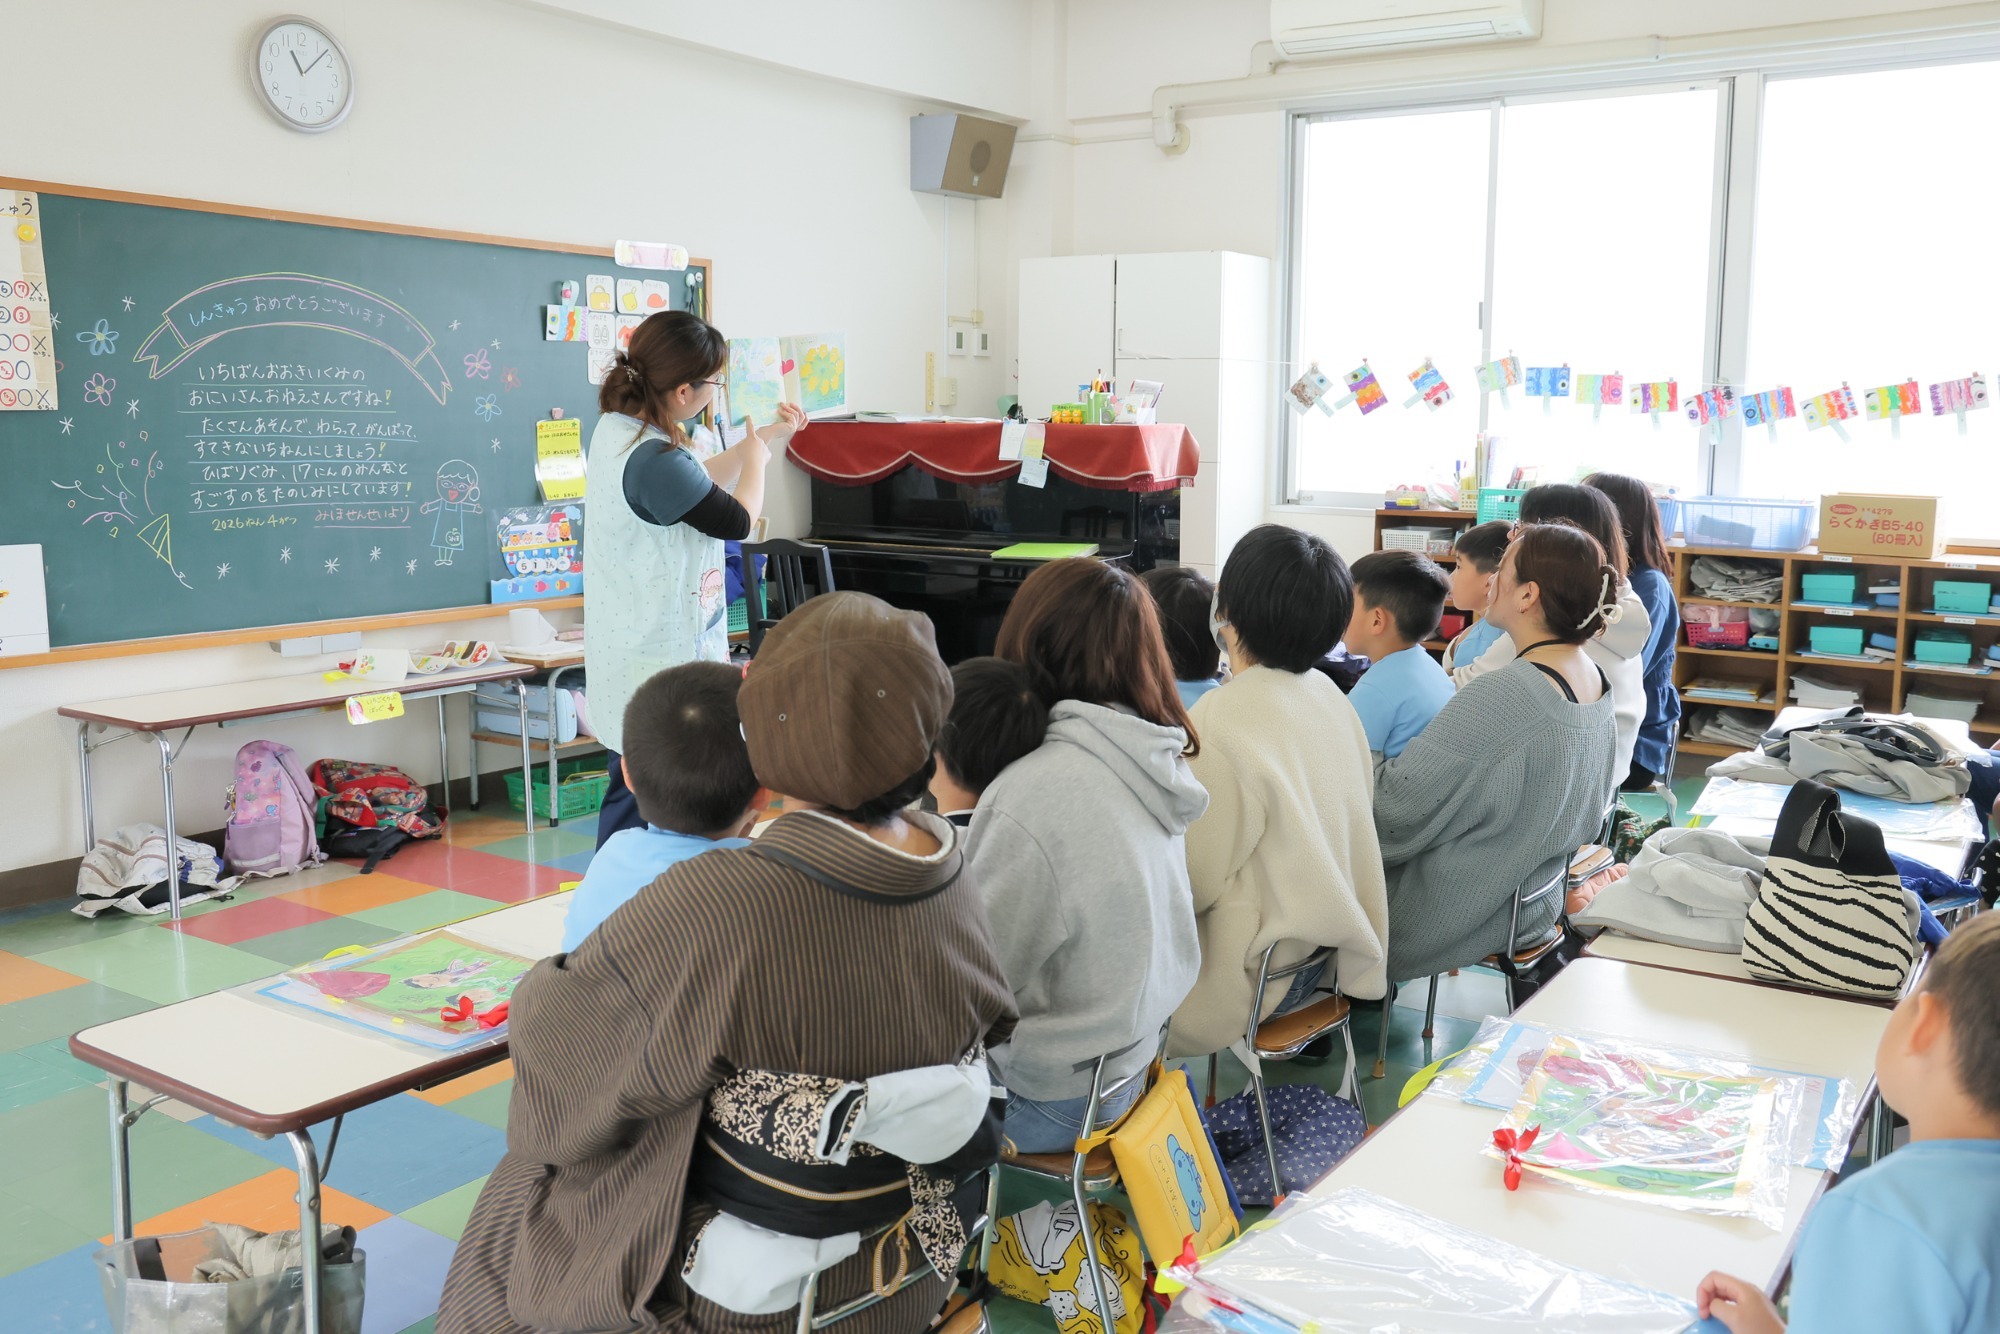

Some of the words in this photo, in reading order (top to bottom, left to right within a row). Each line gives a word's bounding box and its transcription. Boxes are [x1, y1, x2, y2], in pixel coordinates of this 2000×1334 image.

[281, 33, 290, 48] 11
[296, 32, 307, 47] 12
[268, 42, 280, 58] 10
[265, 60, 273, 76] 9
[326, 54, 333, 69] 2
[331, 74, 338, 88] 3
[272, 82, 279, 96] 8
[285, 96, 292, 110] 7
[327, 92, 334, 104] 4
[300, 103, 308, 118] 6
[316, 101, 323, 116] 5
[0, 197, 33, 215] ゅう
[198, 362, 366, 381] いちばんおおきいくみの
[1872, 532, 1923, 546] (80冊入)
